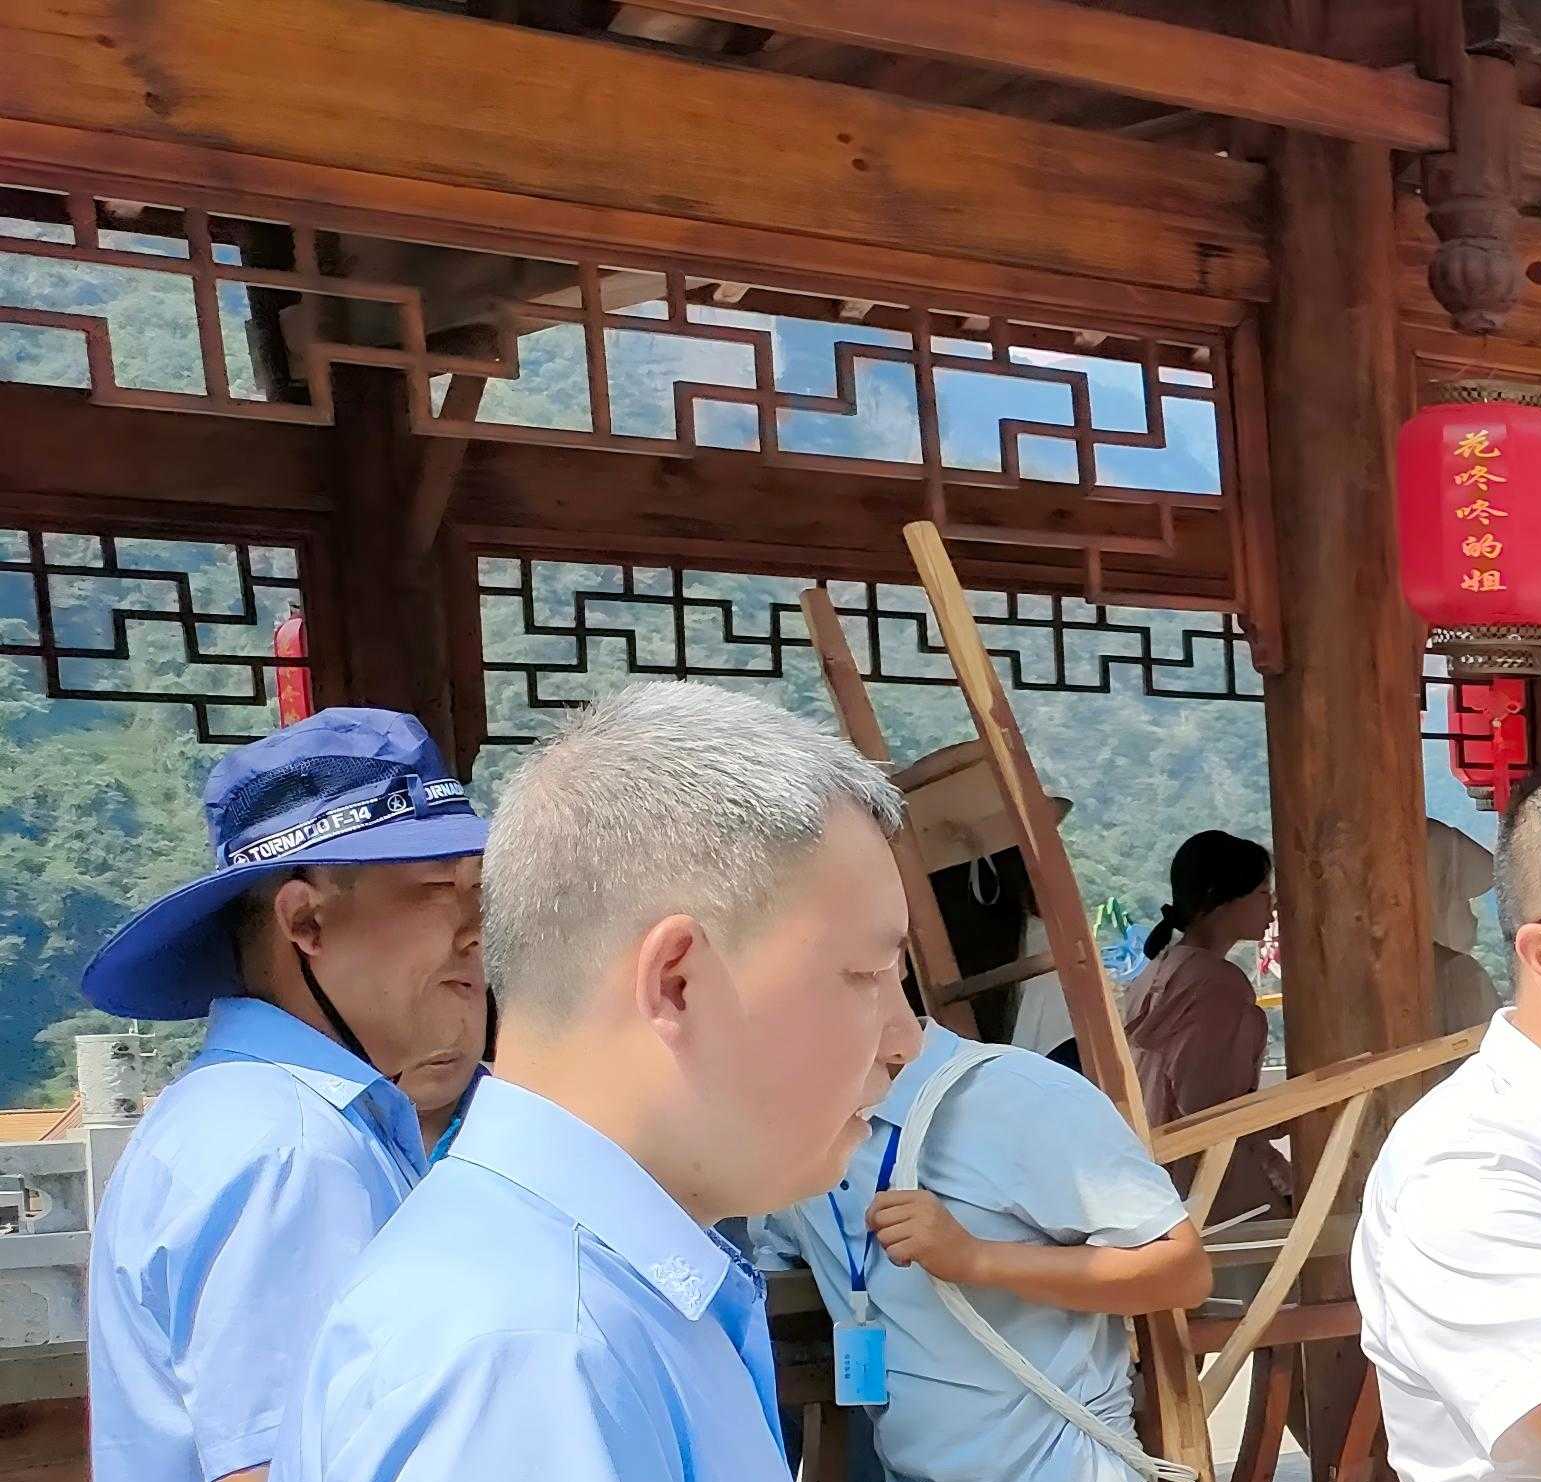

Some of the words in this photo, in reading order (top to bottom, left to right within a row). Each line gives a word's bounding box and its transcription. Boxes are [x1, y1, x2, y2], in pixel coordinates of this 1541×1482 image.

[1453, 429, 1509, 592] 花咚咚的姐
[248, 814, 331, 862] TORNADO
[333, 805, 373, 830] F-14
